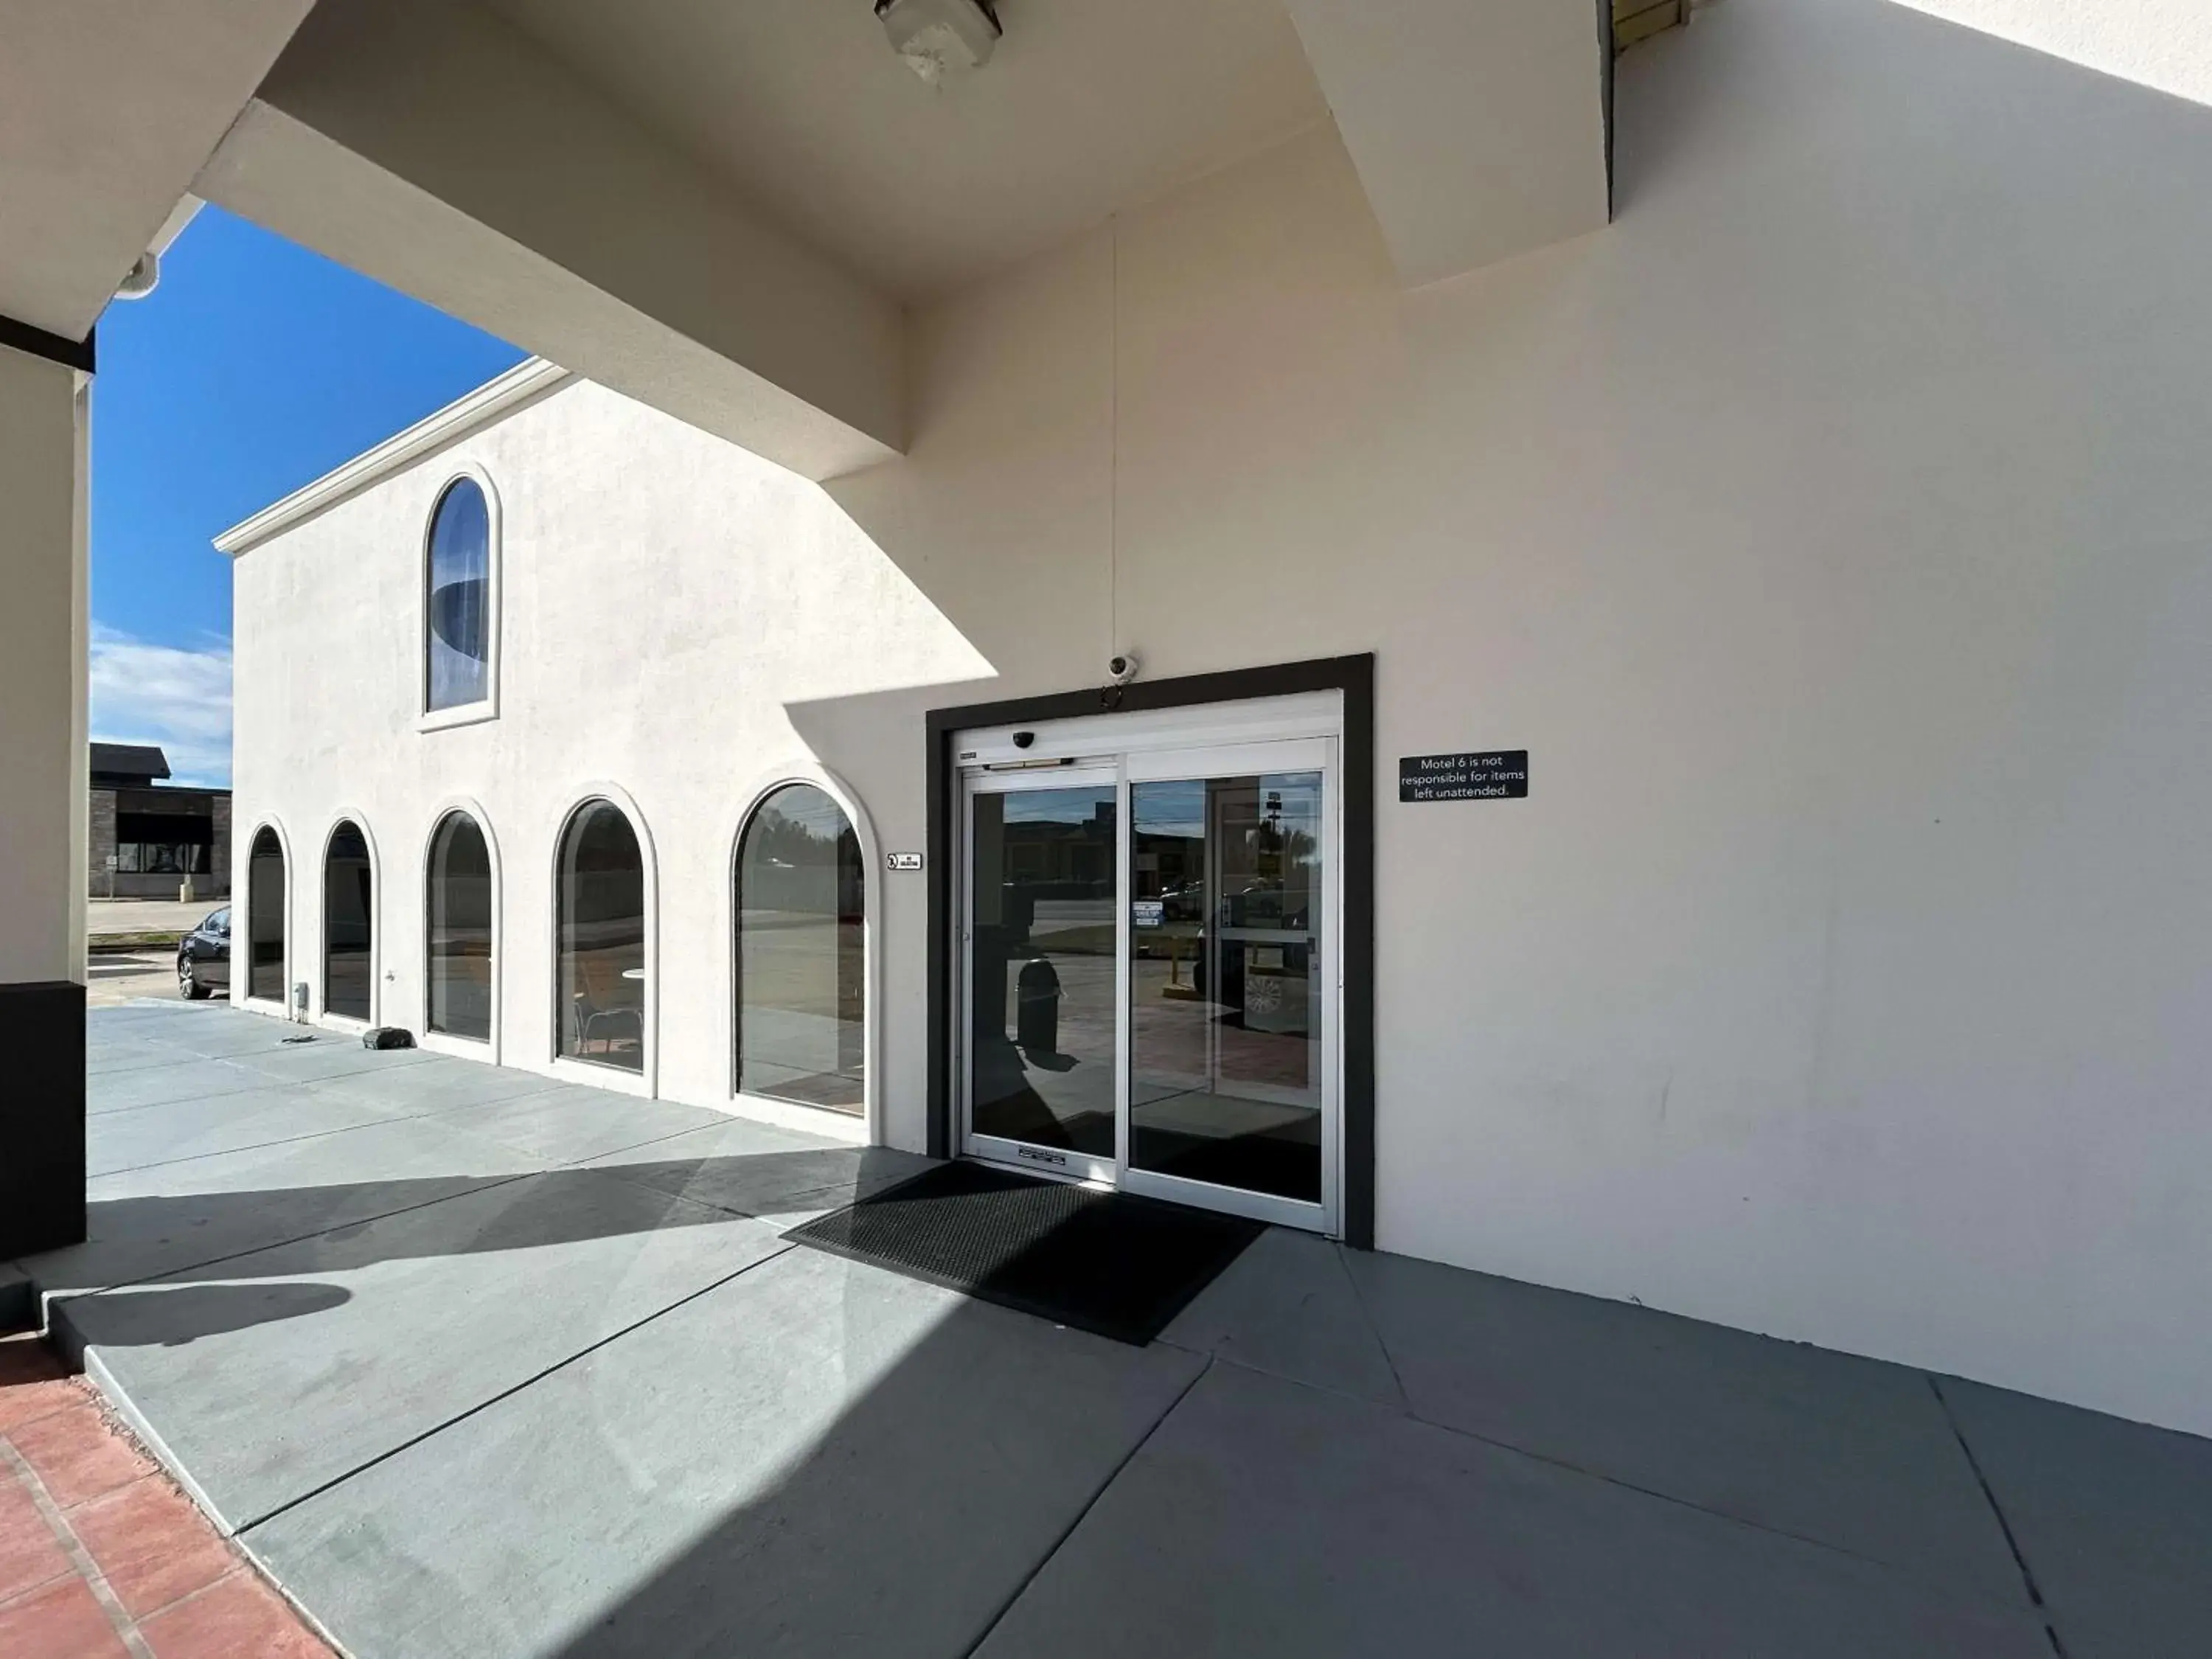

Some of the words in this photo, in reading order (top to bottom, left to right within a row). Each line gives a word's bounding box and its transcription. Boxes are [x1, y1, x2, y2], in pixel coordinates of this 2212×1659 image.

[1421, 757, 1455, 770] Motel
[1458, 758, 1466, 768] 6
[1470, 757, 1478, 768] is
[1481, 757, 1503, 767] not
[1402, 772, 1467, 786] responsible
[1471, 771, 1486, 782] for
[1491, 771, 1525, 781] items
[1415, 788, 1433, 799] left
[1436, 785, 1509, 798] unattended.
